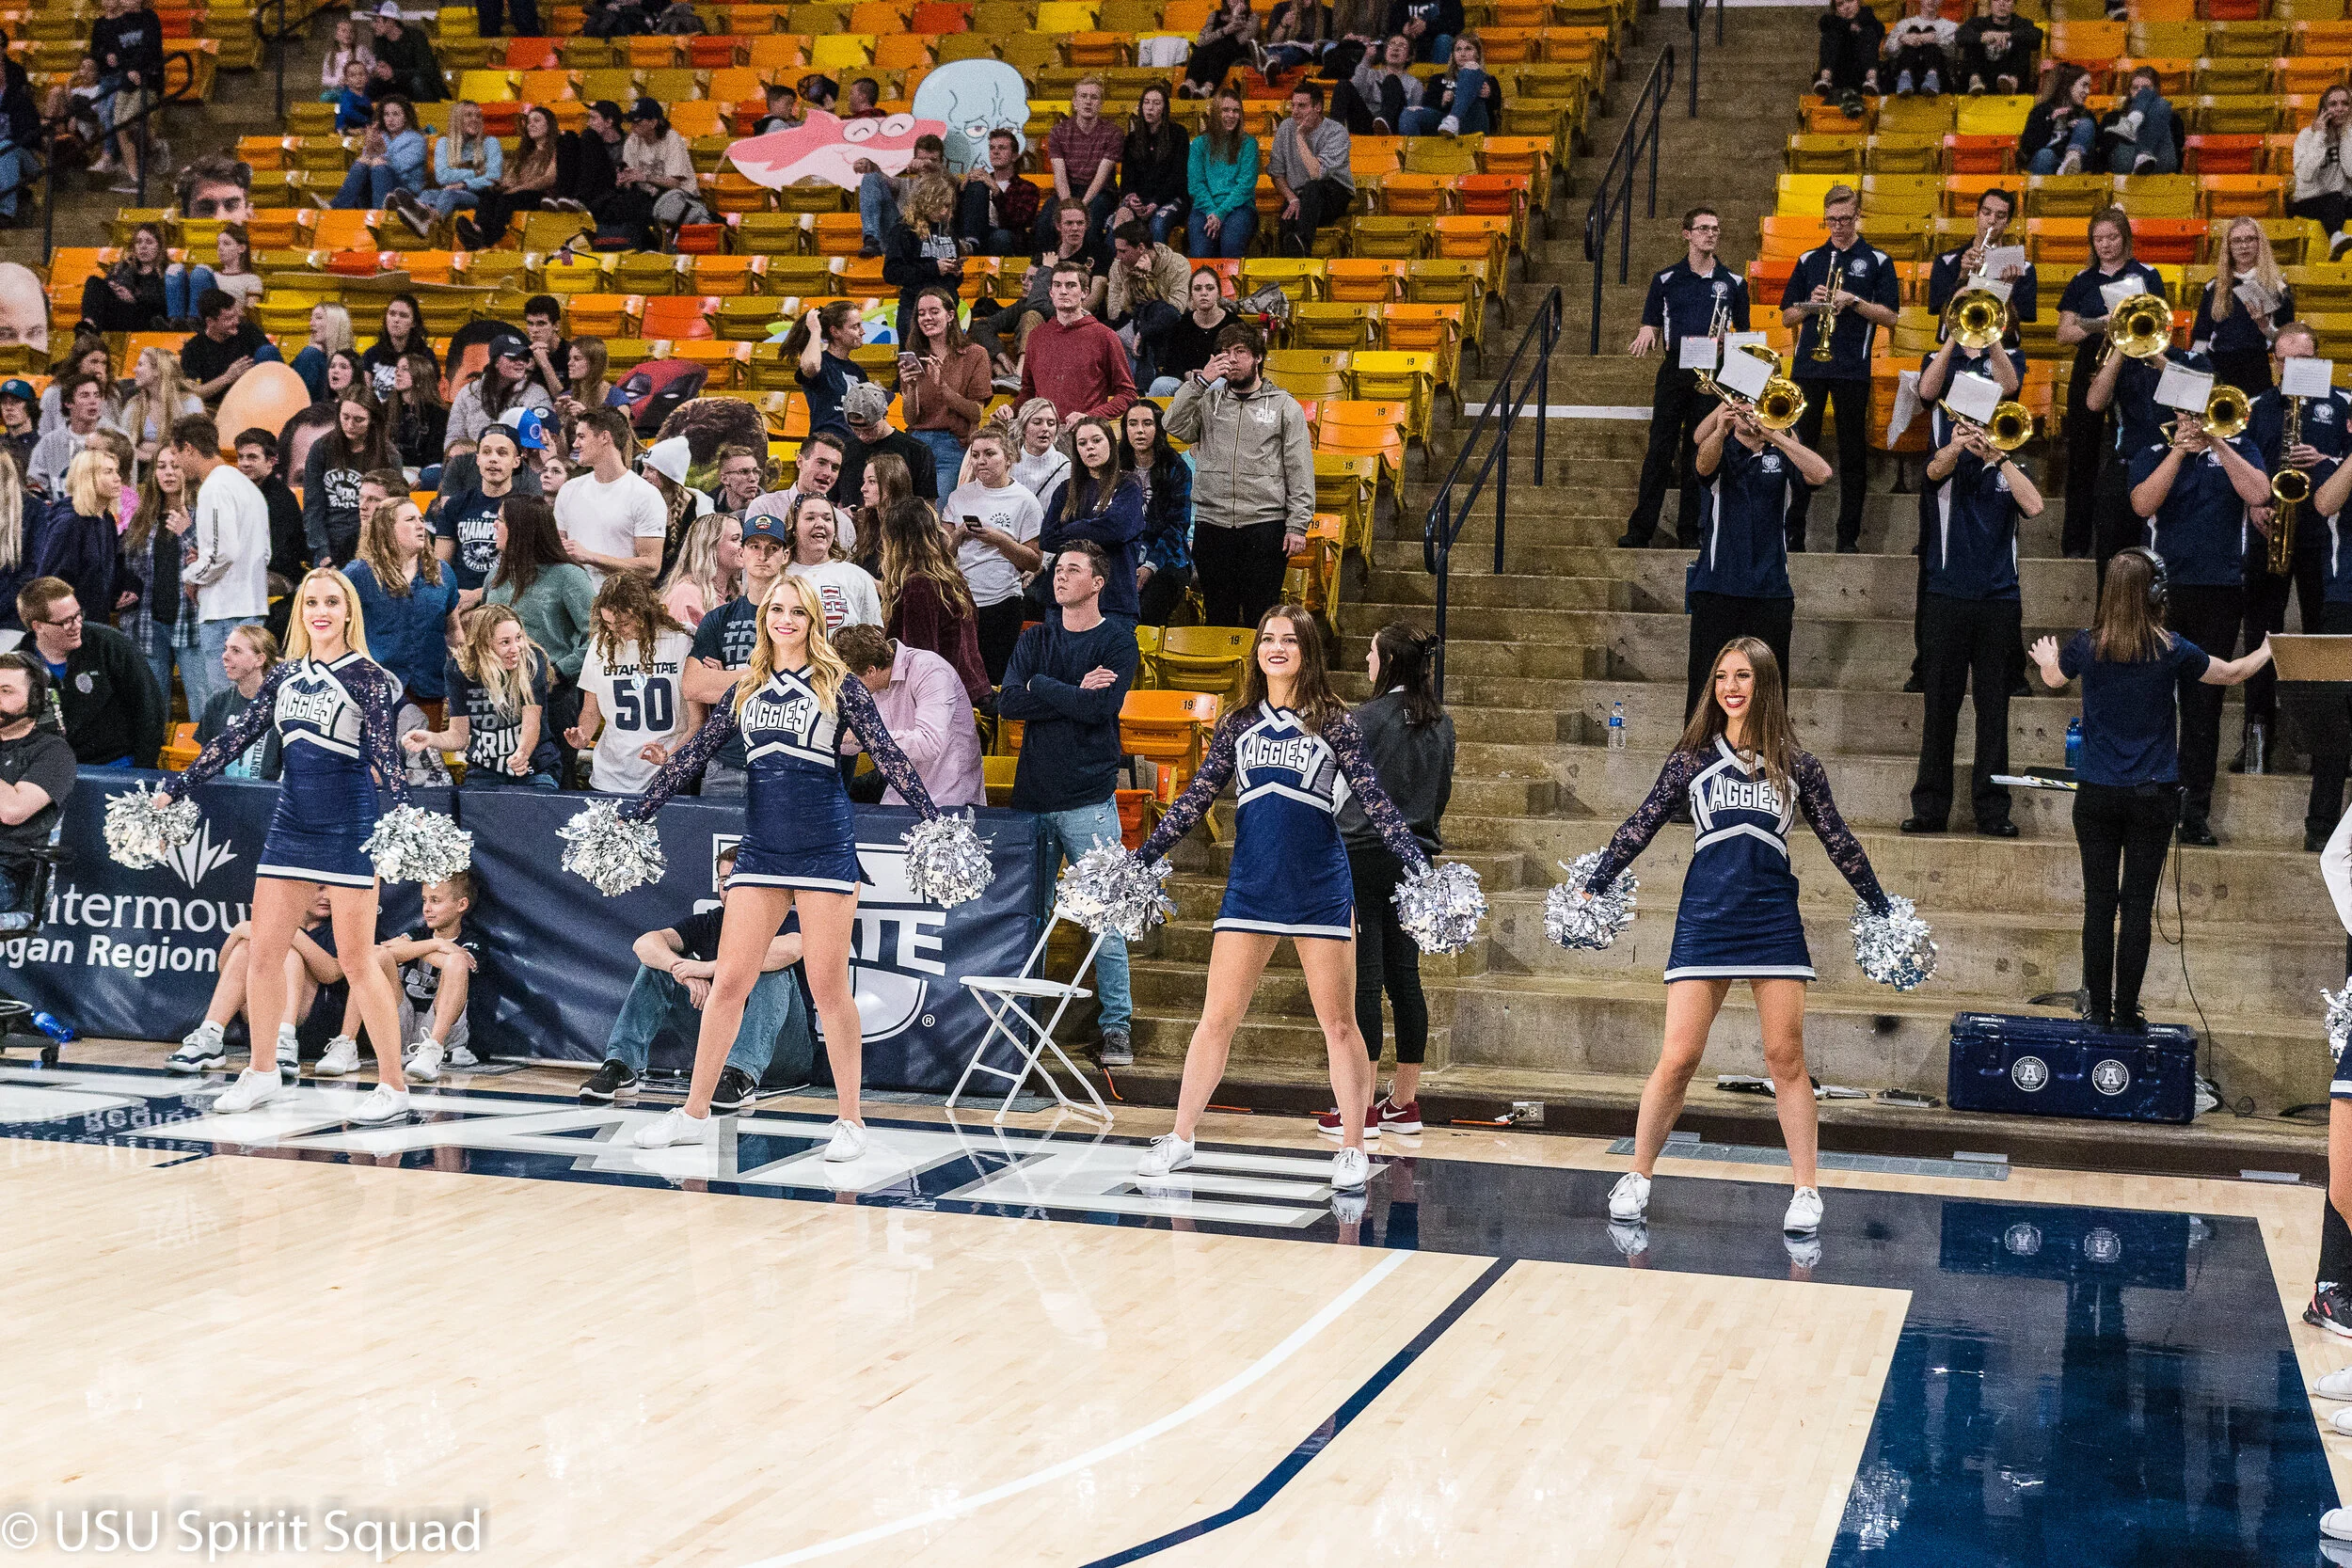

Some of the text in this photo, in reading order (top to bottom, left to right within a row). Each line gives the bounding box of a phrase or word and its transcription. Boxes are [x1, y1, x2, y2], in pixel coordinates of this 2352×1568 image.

[1406, 357, 1415, 366] 19
[1376, 407, 1386, 416] 19
[1344, 461, 1353, 469] 19
[457, 521, 498, 544] CHAMP
[1311, 520, 1320, 529] 19
[1230, 635, 1240, 644] 19
[278, 685, 338, 726] AGGIES
[613, 677, 674, 732] 50
[1184, 700, 1193, 709] 19
[743, 696, 812, 735] AGGIES
[1242, 732, 1314, 773] AGGIES
[1708, 772, 1784, 817] AGGIES
[47, 882, 252, 934] termou
[0, 934, 217, 977] gan Region
[2021, 1064, 2039, 1081] A
[2102, 1068, 2120, 1085] A
